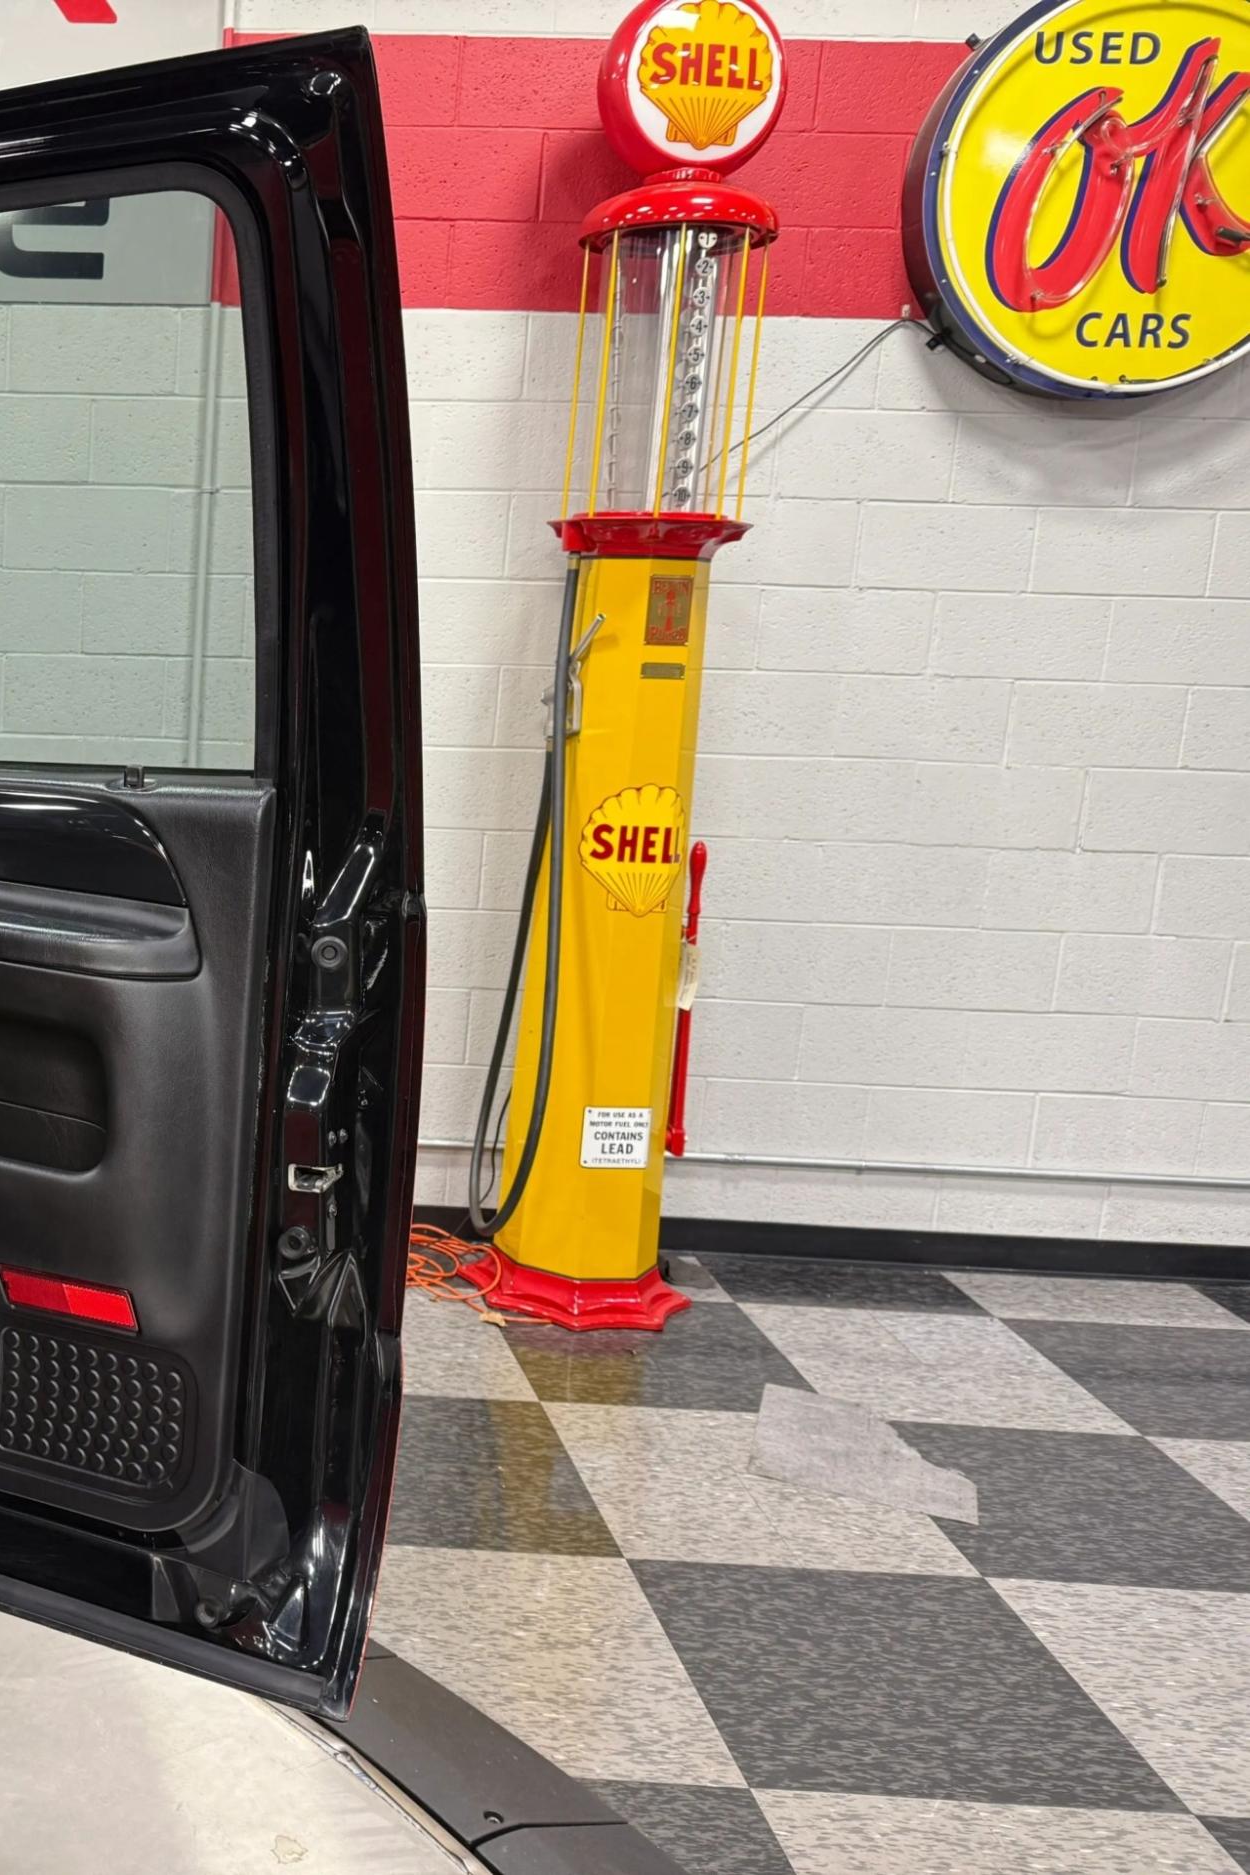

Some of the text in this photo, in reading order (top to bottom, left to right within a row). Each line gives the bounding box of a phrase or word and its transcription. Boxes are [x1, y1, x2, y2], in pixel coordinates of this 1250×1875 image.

[1034, 31, 1162, 65] USED
[650, 42, 764, 91] SHELL
[1075, 312, 1192, 349] CARS
[590, 823, 680, 864] SHELL
[594, 1131, 644, 1141] CONTAINS
[601, 1143, 634, 1155] LEAD
